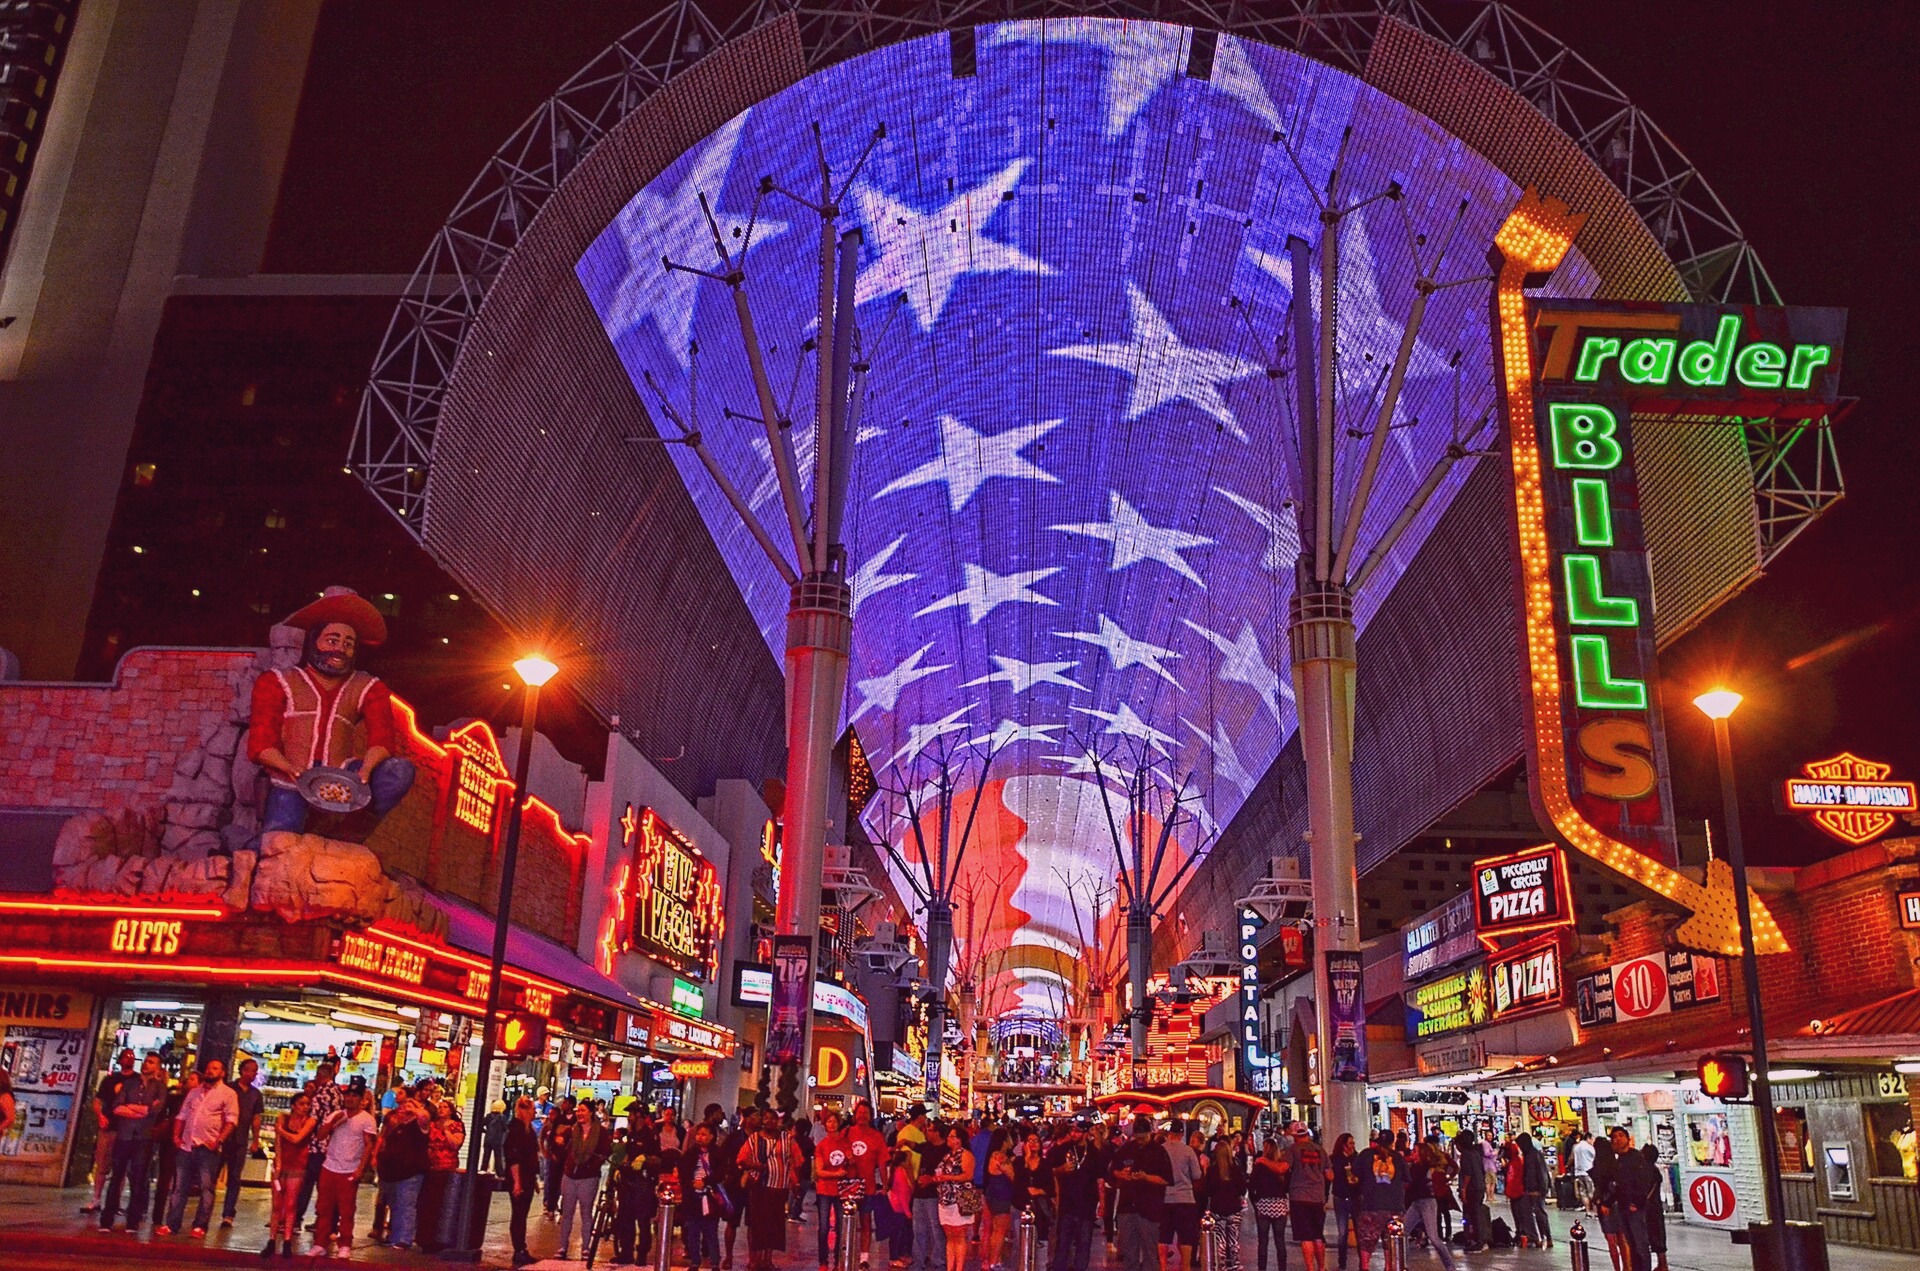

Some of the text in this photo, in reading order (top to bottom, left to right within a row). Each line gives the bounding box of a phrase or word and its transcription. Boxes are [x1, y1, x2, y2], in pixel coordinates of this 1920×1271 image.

[1533, 310, 1831, 389] Trader
[1549, 403, 1657, 799] BILLS
[1818, 758, 1878, 780] MOTOR
[1792, 784, 1910, 806] HARLEY-DAVIDSON
[1826, 811, 1886, 836] CYCLES
[1501, 857, 1548, 879] PICCADILLY
[1510, 873, 1542, 889] CIRCUS
[1490, 888, 1545, 920] PIZZA
[112, 919, 182, 955] GIFTS
[1512, 949, 1556, 1002] PIZZA
[1622, 964, 1653, 1012] $10
[1416, 976, 1467, 1005] SOUVENIRS
[0, 991, 70, 1020] NIRS
[1421, 995, 1463, 1019] T-SHIRTS
[1417, 1010, 1468, 1036] BEVERAGES
[51, 1063, 72, 1072] FOR
[671, 1063, 710, 1076] LIQUOR
[817, 1046, 848, 1087] D
[1696, 1180, 1724, 1217] $10
